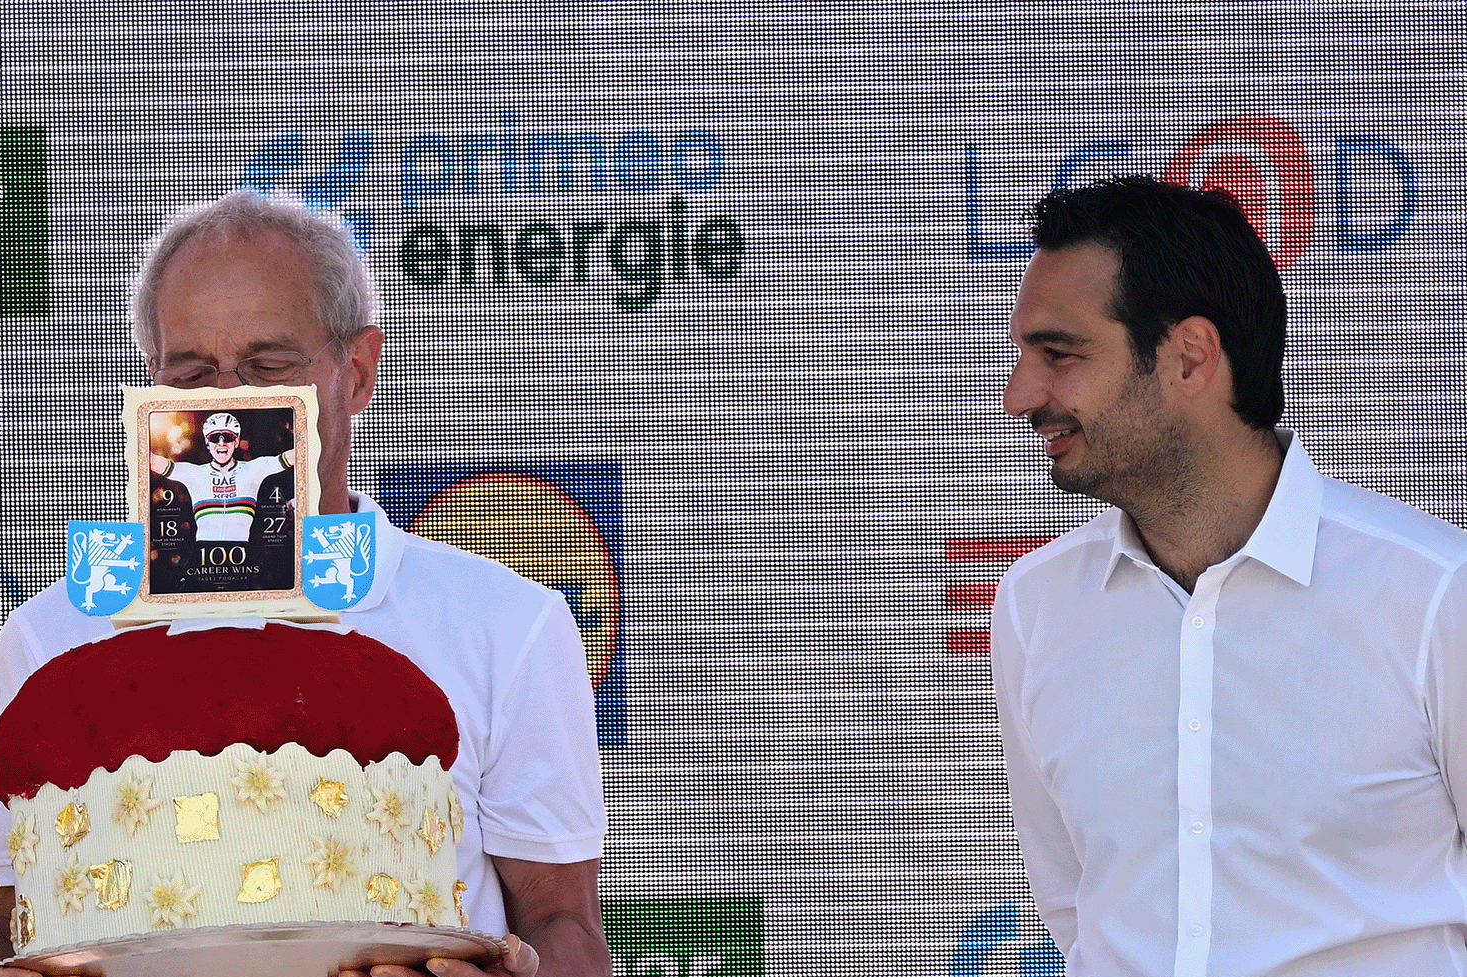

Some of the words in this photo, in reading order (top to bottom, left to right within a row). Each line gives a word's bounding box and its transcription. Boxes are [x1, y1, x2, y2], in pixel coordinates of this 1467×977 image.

[401, 110, 726, 208] primeo
[400, 197, 746, 312] energie
[212, 476, 236, 486] UAE
[162, 489, 174, 507] 9
[269, 486, 281, 503] 4
[159, 520, 178, 537] 18
[263, 517, 286, 533] 27
[199, 546, 247, 566] 100
[186, 567, 228, 576] CAREER
[232, 565, 260, 574] WINS
